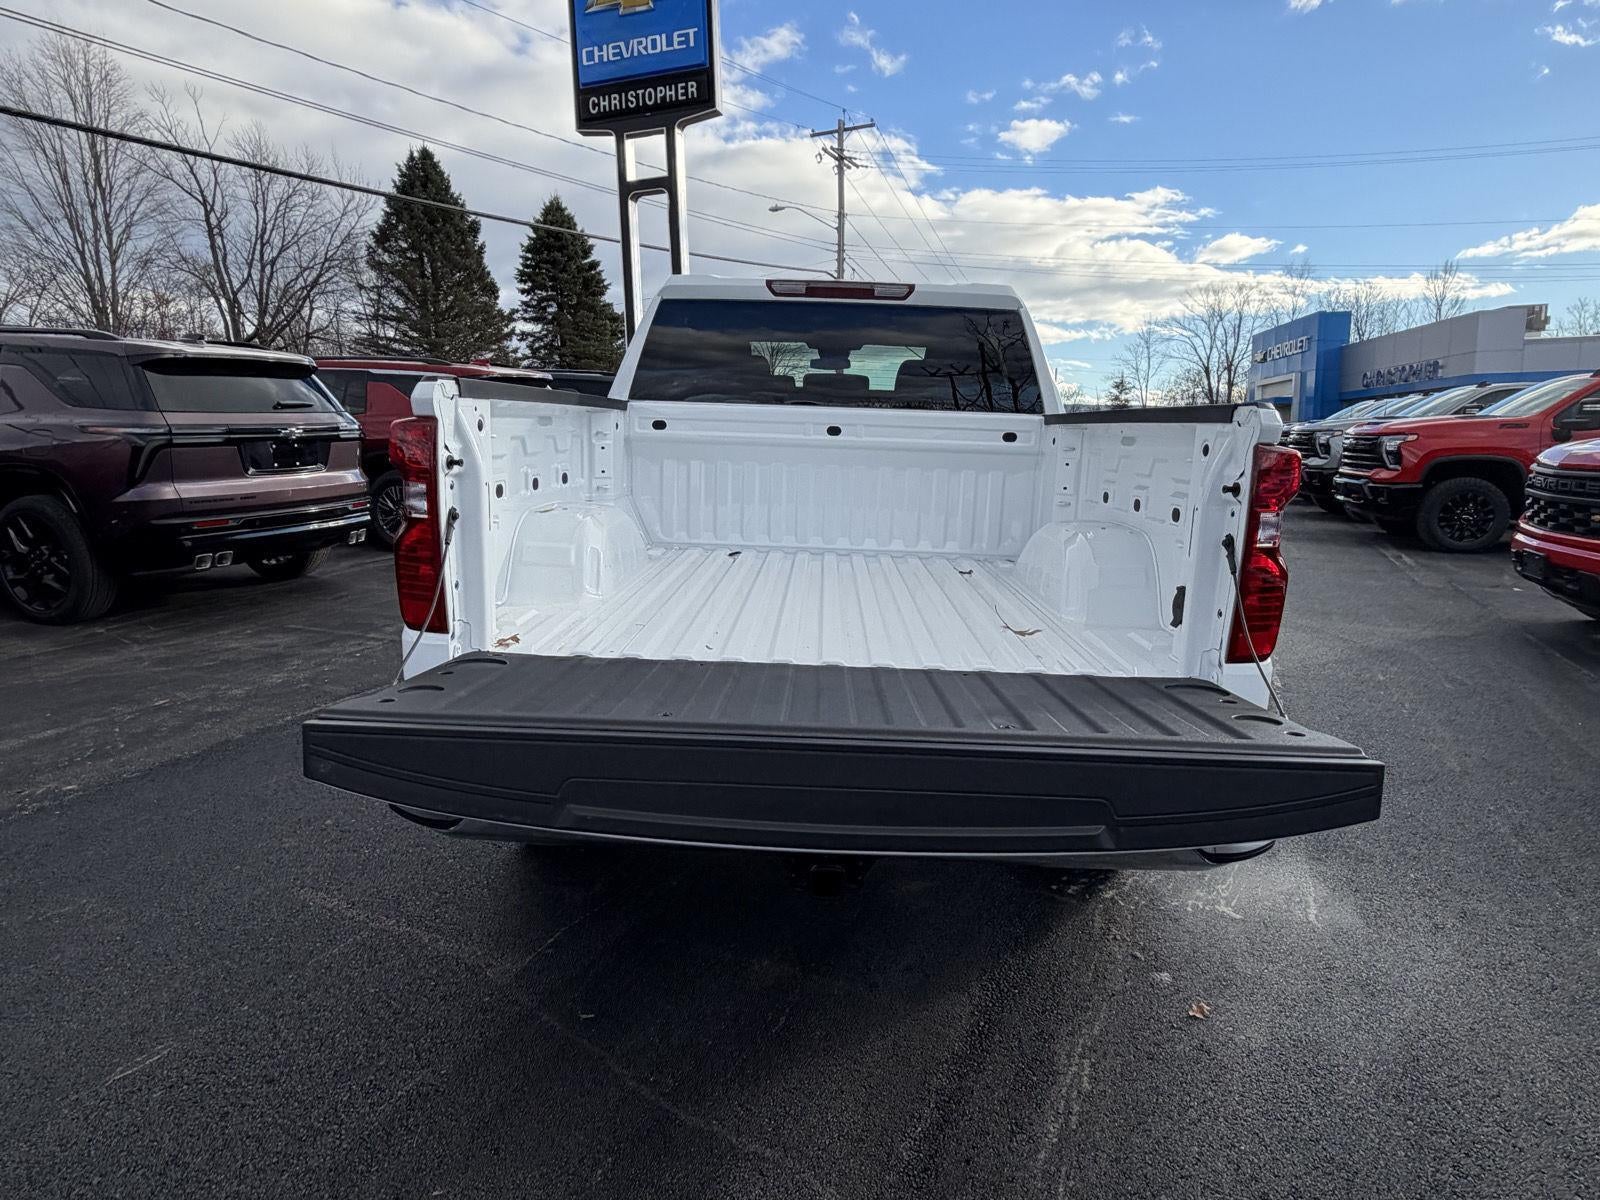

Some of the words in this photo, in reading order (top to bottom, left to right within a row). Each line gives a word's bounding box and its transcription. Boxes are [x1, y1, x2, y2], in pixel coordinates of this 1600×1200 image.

[582, 27, 698, 66] CHEVROLET
[589, 81, 698, 114] CHRISTOPHER
[1267, 335, 1310, 362] CHEVROLET
